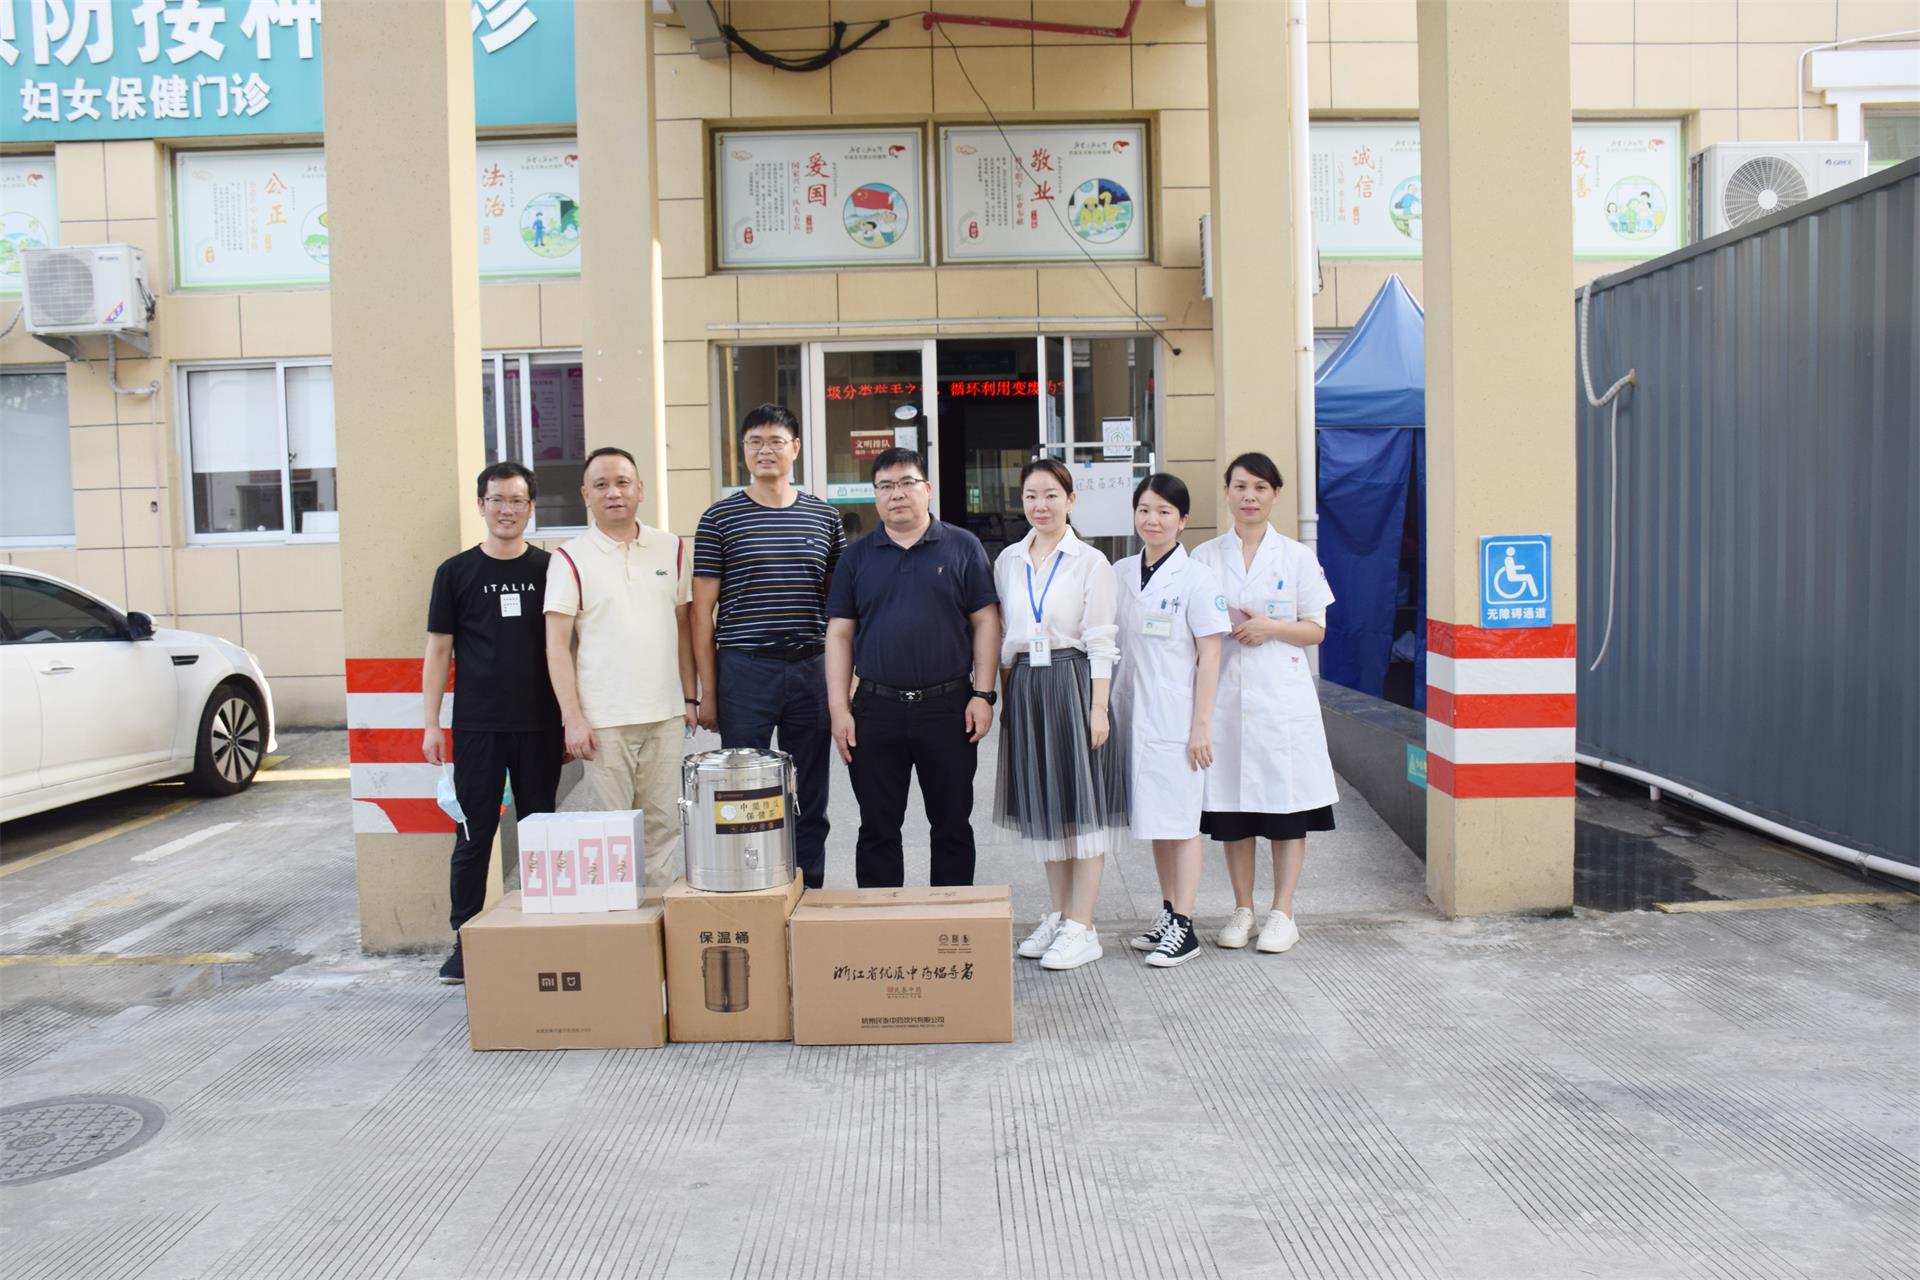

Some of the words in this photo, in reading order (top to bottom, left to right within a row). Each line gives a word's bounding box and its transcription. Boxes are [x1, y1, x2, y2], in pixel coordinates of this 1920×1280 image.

[0, 0, 321, 65] 防接种
[20, 72, 272, 122] 妇女保健门诊
[264, 171, 289, 226] 公正
[482, 162, 505, 217] 法治
[804, 152, 830, 207] 爱国
[1030, 147, 1055, 202] 敬业
[1352, 143, 1376, 199] 诚信
[483, 583, 536, 594] ITALIA
[1487, 607, 1546, 620] 无障碍通道
[699, 931, 749, 944] 保温桶
[833, 962, 974, 981] 浙江省优质中药倡导者
